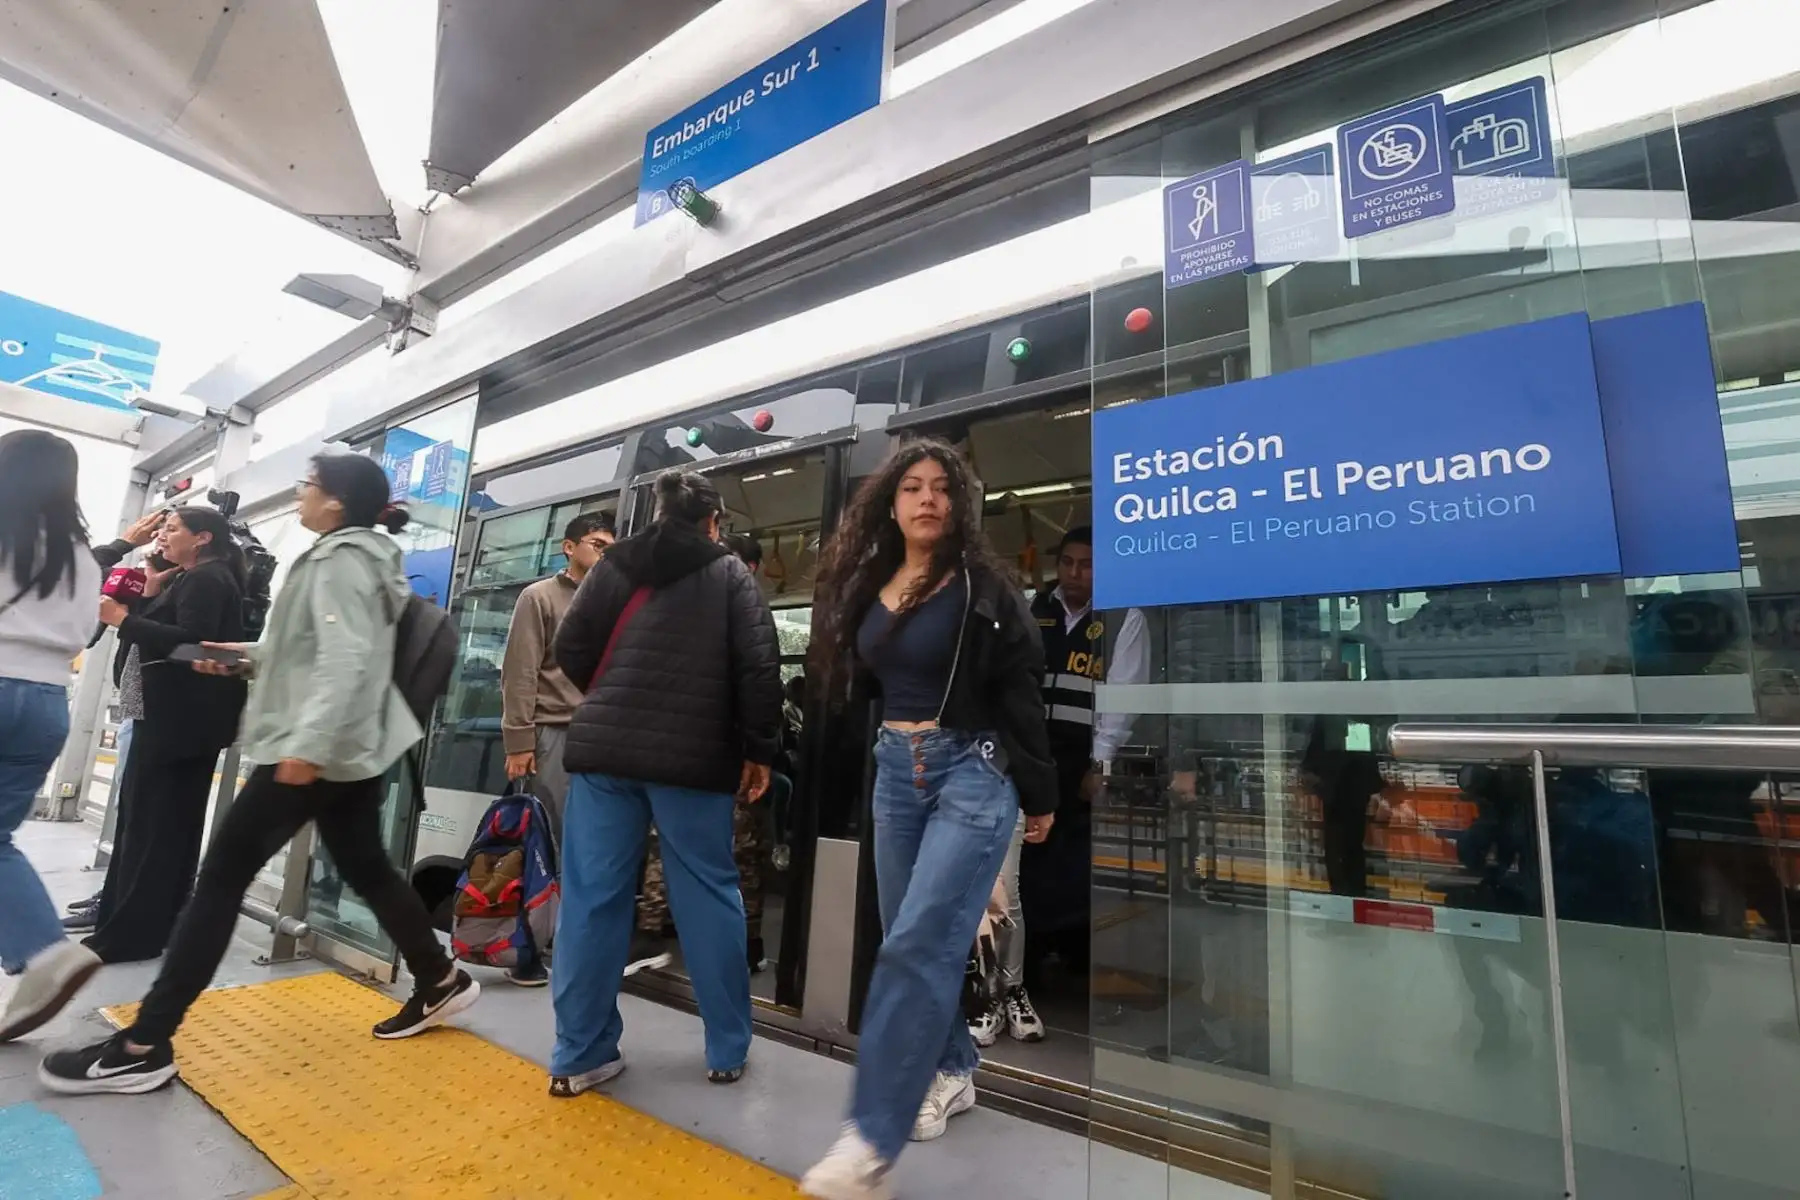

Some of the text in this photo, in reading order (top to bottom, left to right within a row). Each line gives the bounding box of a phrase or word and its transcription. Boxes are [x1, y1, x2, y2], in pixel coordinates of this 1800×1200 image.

[652, 47, 820, 159] Embarque Sur 1
[650, 152, 680, 178] South
[683, 126, 732, 160] boarding
[1352, 190, 1444, 222] EN ESTACIONES
[1364, 183, 1429, 208] NO COMAS
[1374, 208, 1422, 227] Y BUSES
[1180, 240, 1236, 263] PROHIBIDO
[1184, 250, 1233, 270] APOYARSE
[1171, 255, 1249, 283] EN LAS PUERTAS
[1113, 432, 1284, 484] Estación
[1114, 443, 1552, 523] Quilca - El Peruano
[1114, 528, 1198, 557] Quilca
[1231, 519, 1254, 544] El
[1265, 508, 1397, 541] Peruano
[1408, 491, 1536, 525] Station
